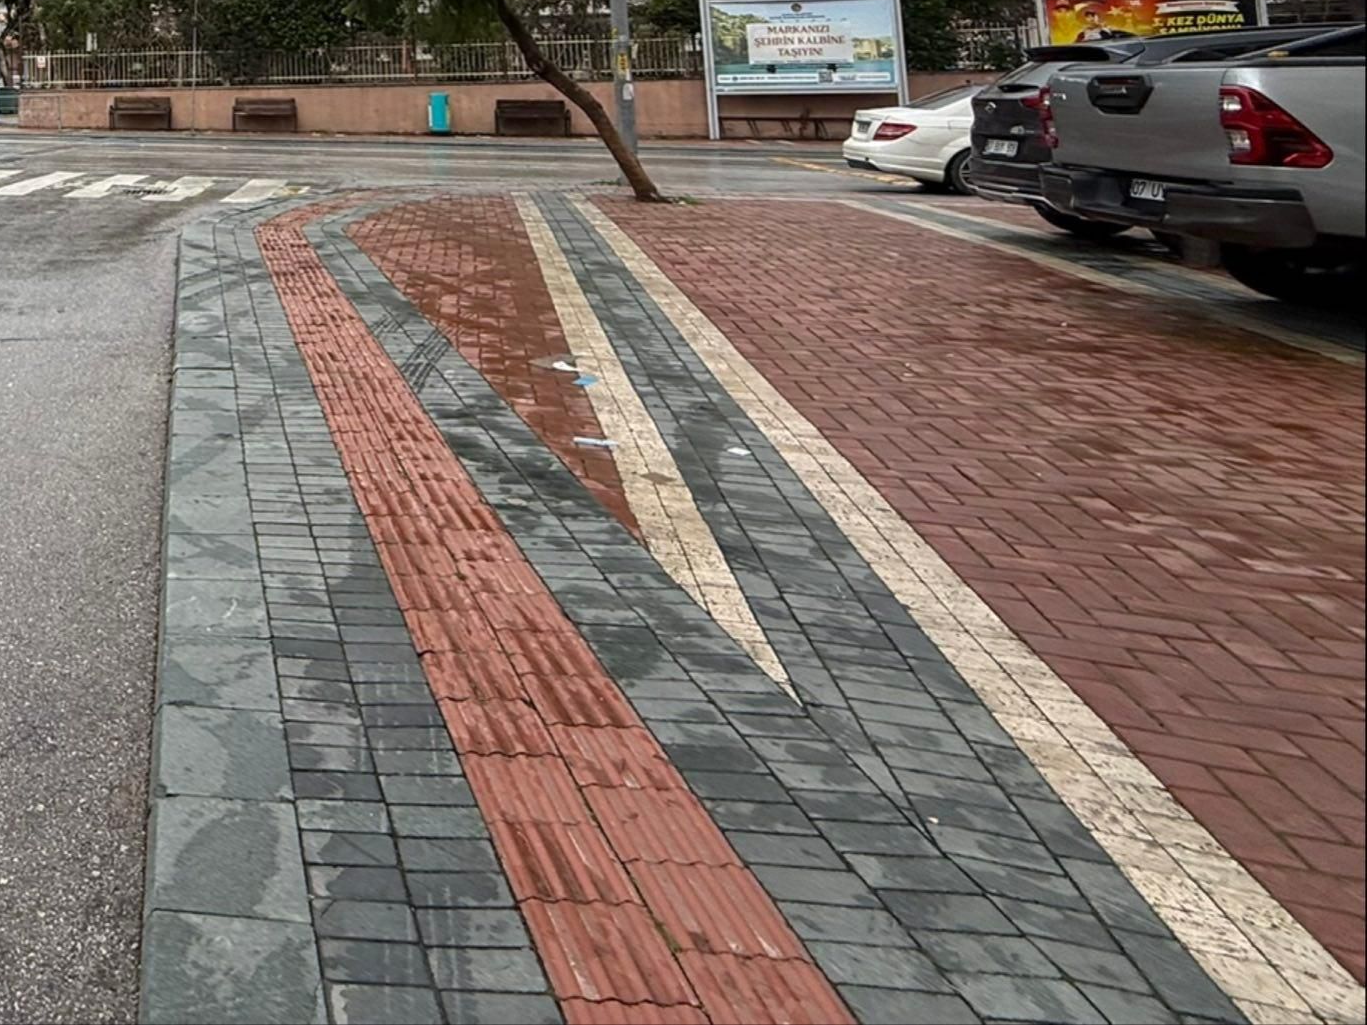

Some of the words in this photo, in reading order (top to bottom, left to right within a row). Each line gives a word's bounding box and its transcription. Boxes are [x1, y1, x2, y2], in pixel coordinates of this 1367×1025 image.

[1167, 16, 1194, 27] KEZ
[1196, 13, 1245, 24] DÜNYA
[767, 25, 830, 34] MARKANIZI
[754, 37, 795, 48] ŞEHRİN
[798, 34, 846, 45] KALBİNE
